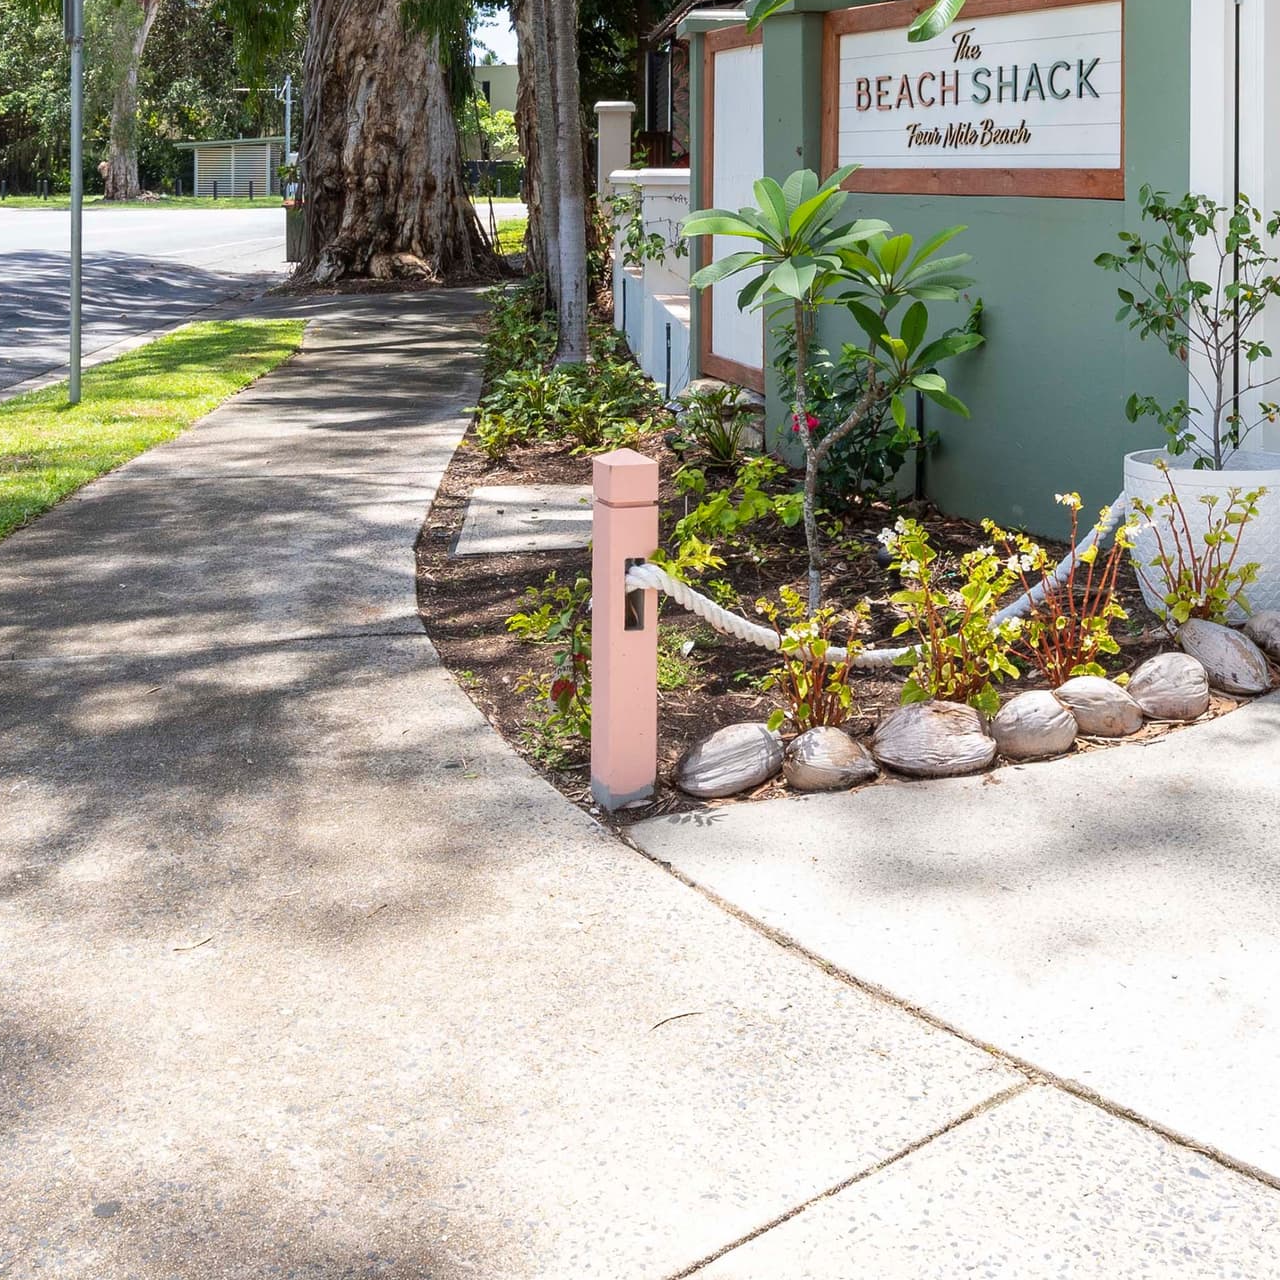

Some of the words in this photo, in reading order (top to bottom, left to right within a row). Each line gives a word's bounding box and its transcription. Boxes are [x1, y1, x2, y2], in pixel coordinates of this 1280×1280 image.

[952, 27, 982, 63] The
[855, 69, 960, 112] BEACH
[971, 57, 1100, 104] SHACK
[906, 122, 941, 148] Four
[943, 122, 979, 149] Mile
[979, 118, 1032, 147] Beach
